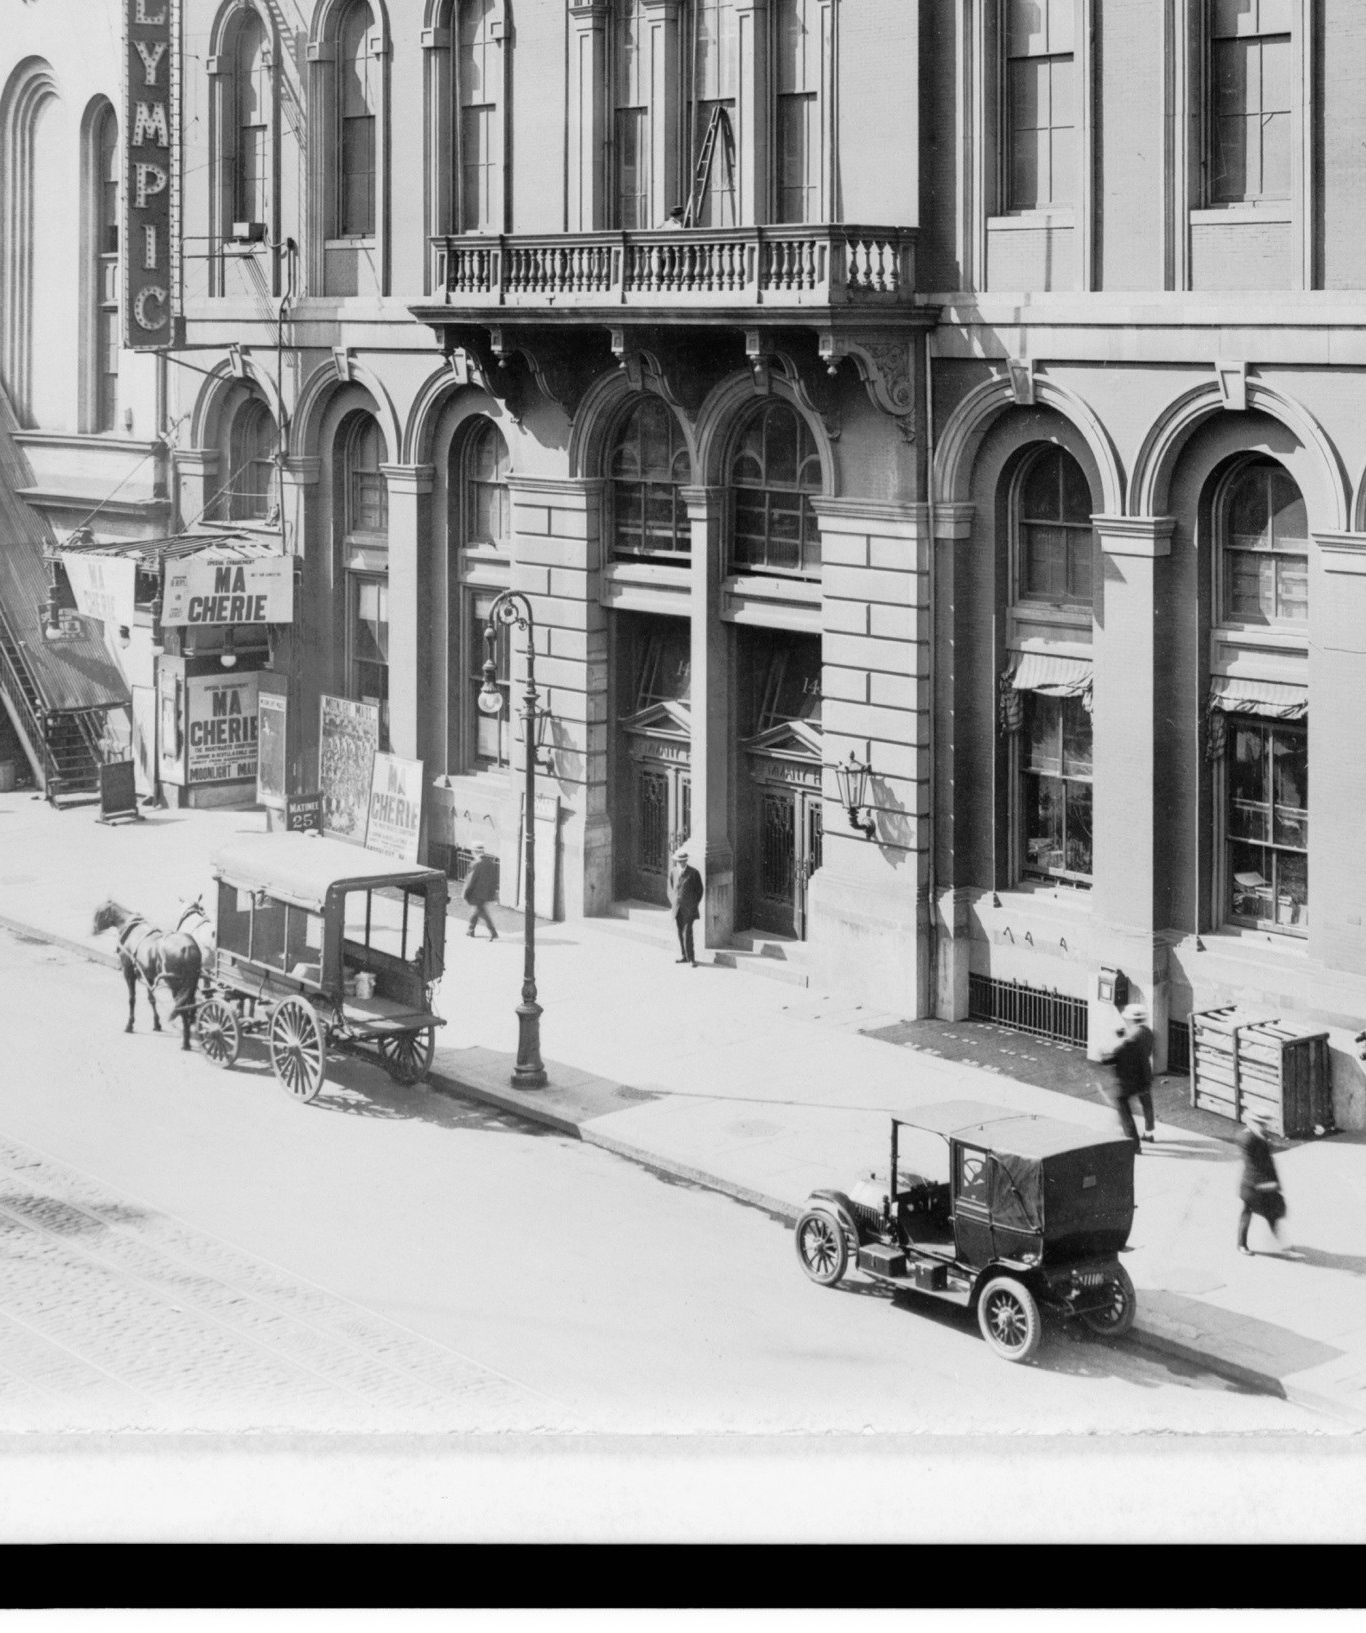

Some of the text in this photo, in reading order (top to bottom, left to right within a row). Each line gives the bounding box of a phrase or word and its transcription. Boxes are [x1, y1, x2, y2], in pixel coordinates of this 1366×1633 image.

[214, 567, 246, 593] MA
[188, 595, 267, 622] CHERIE
[213, 690, 241, 717] MA
[190, 716, 258, 746] CHERIE
[289, 802, 319, 814] MATINEE
[372, 793, 418, 830] CHERIE
